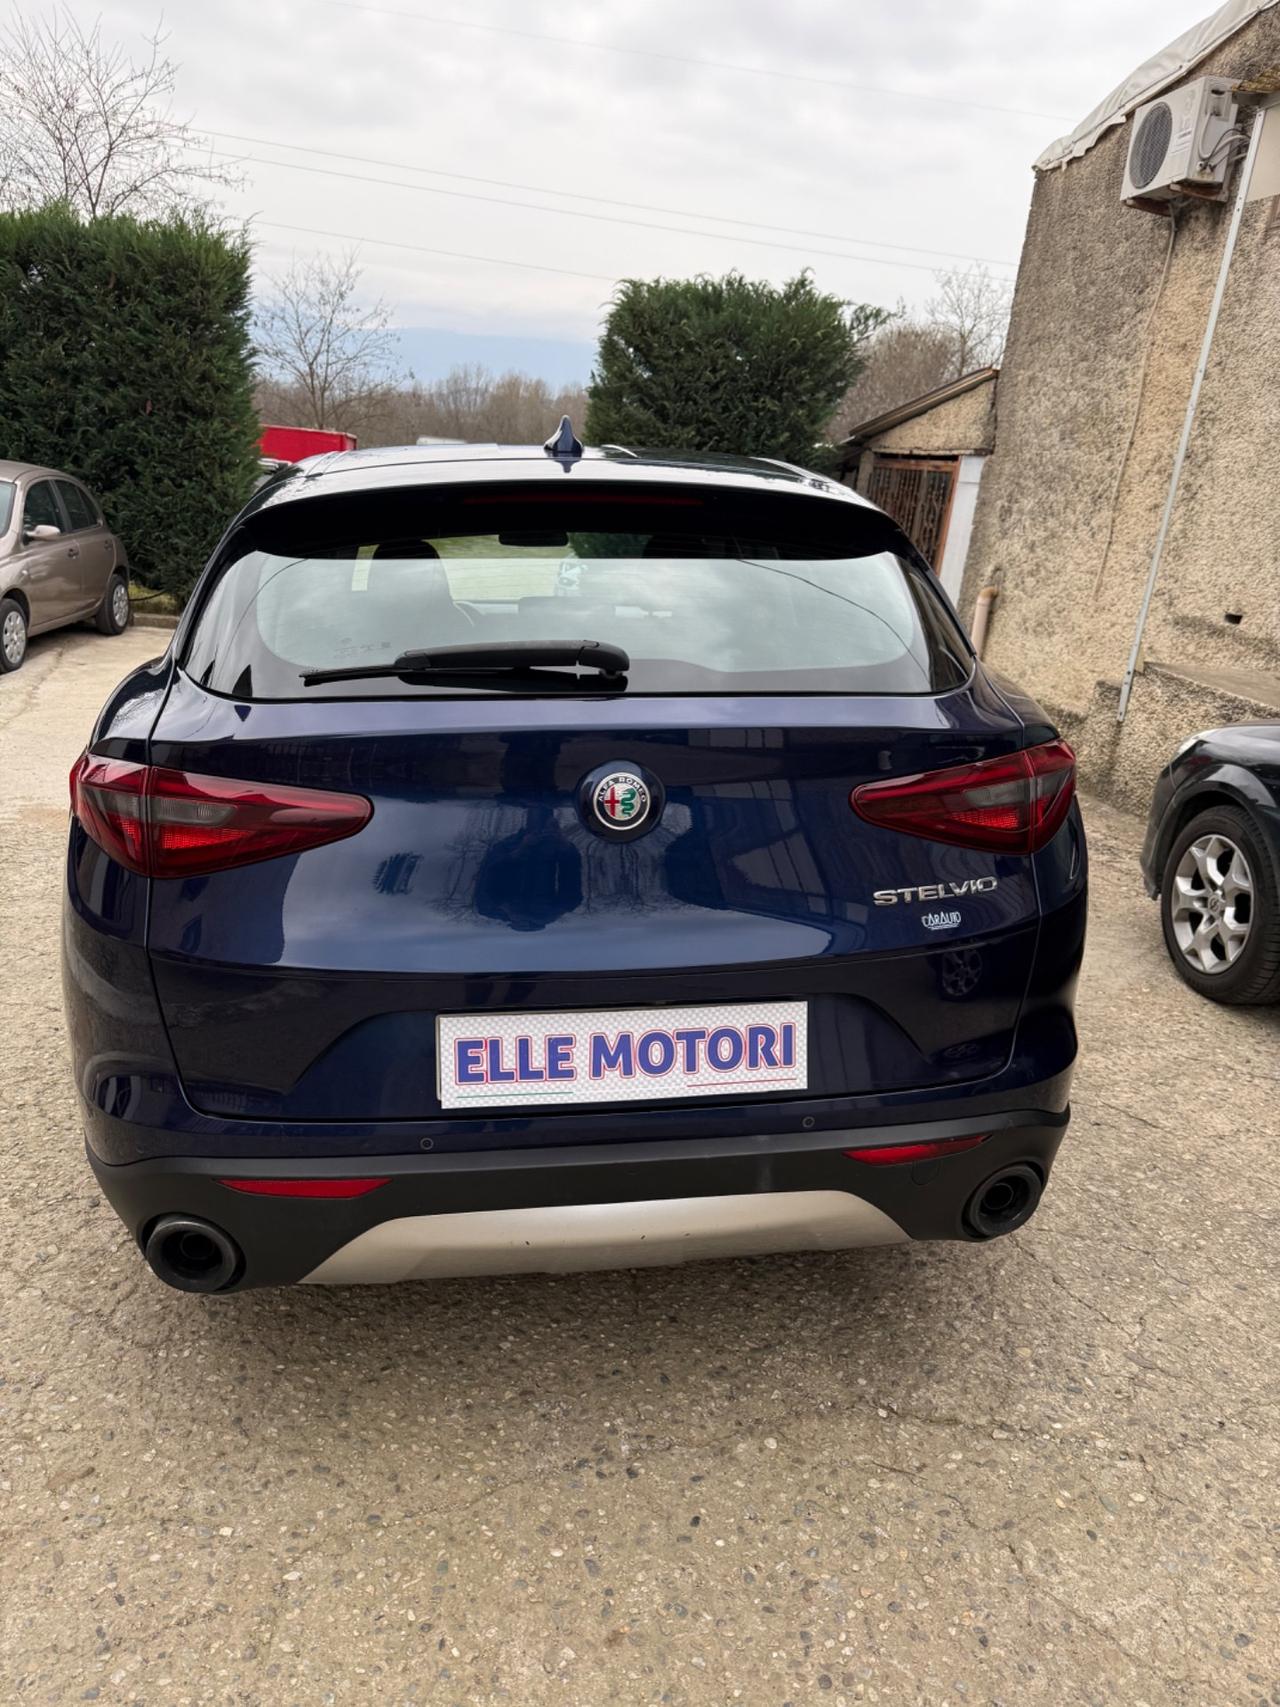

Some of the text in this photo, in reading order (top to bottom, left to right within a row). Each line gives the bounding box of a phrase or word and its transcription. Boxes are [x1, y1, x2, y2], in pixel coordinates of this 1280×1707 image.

[598, 776, 647, 802] ALFA ROMEO
[873, 876, 998, 906] STELVIO
[454, 1022, 796, 1085] ELLE MOTORI
